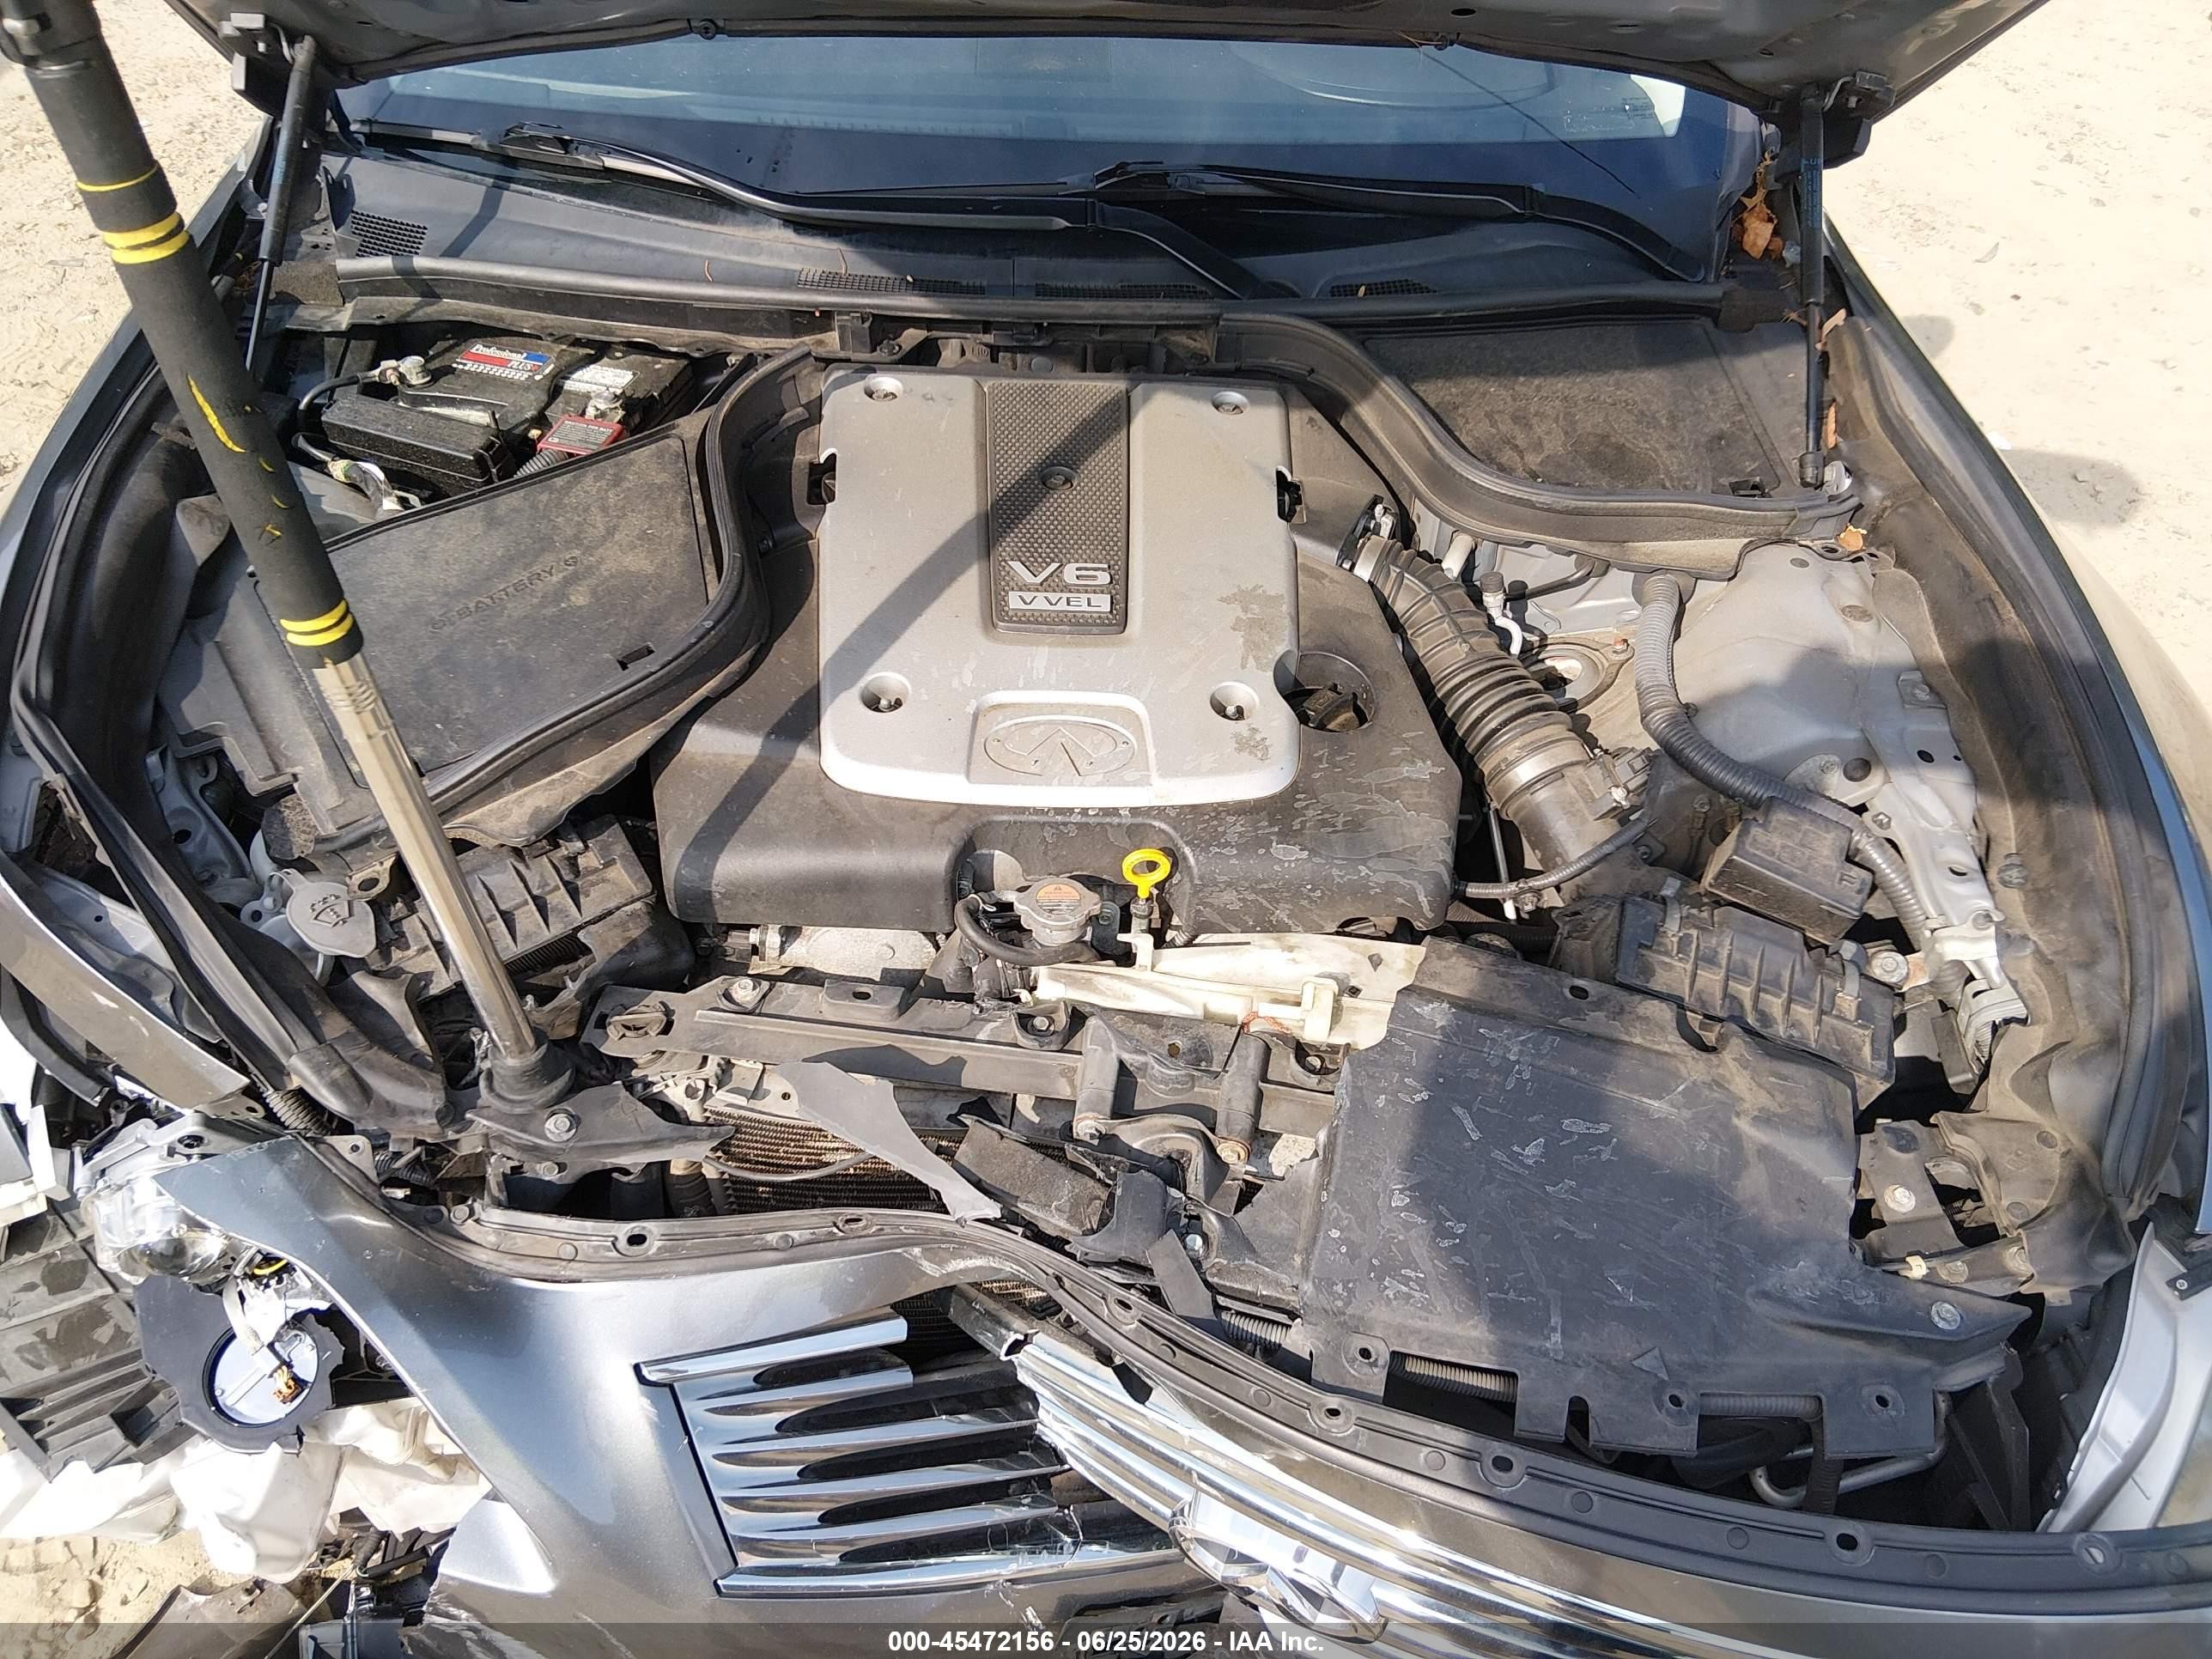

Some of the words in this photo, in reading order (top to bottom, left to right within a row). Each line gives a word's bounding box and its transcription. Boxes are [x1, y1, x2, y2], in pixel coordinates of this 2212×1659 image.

[470, 343, 527, 359] Professional
[1007, 561, 1112, 586] V6
[456, 565, 555, 619] BATTERY
[1017, 594, 1103, 608] VVEL
